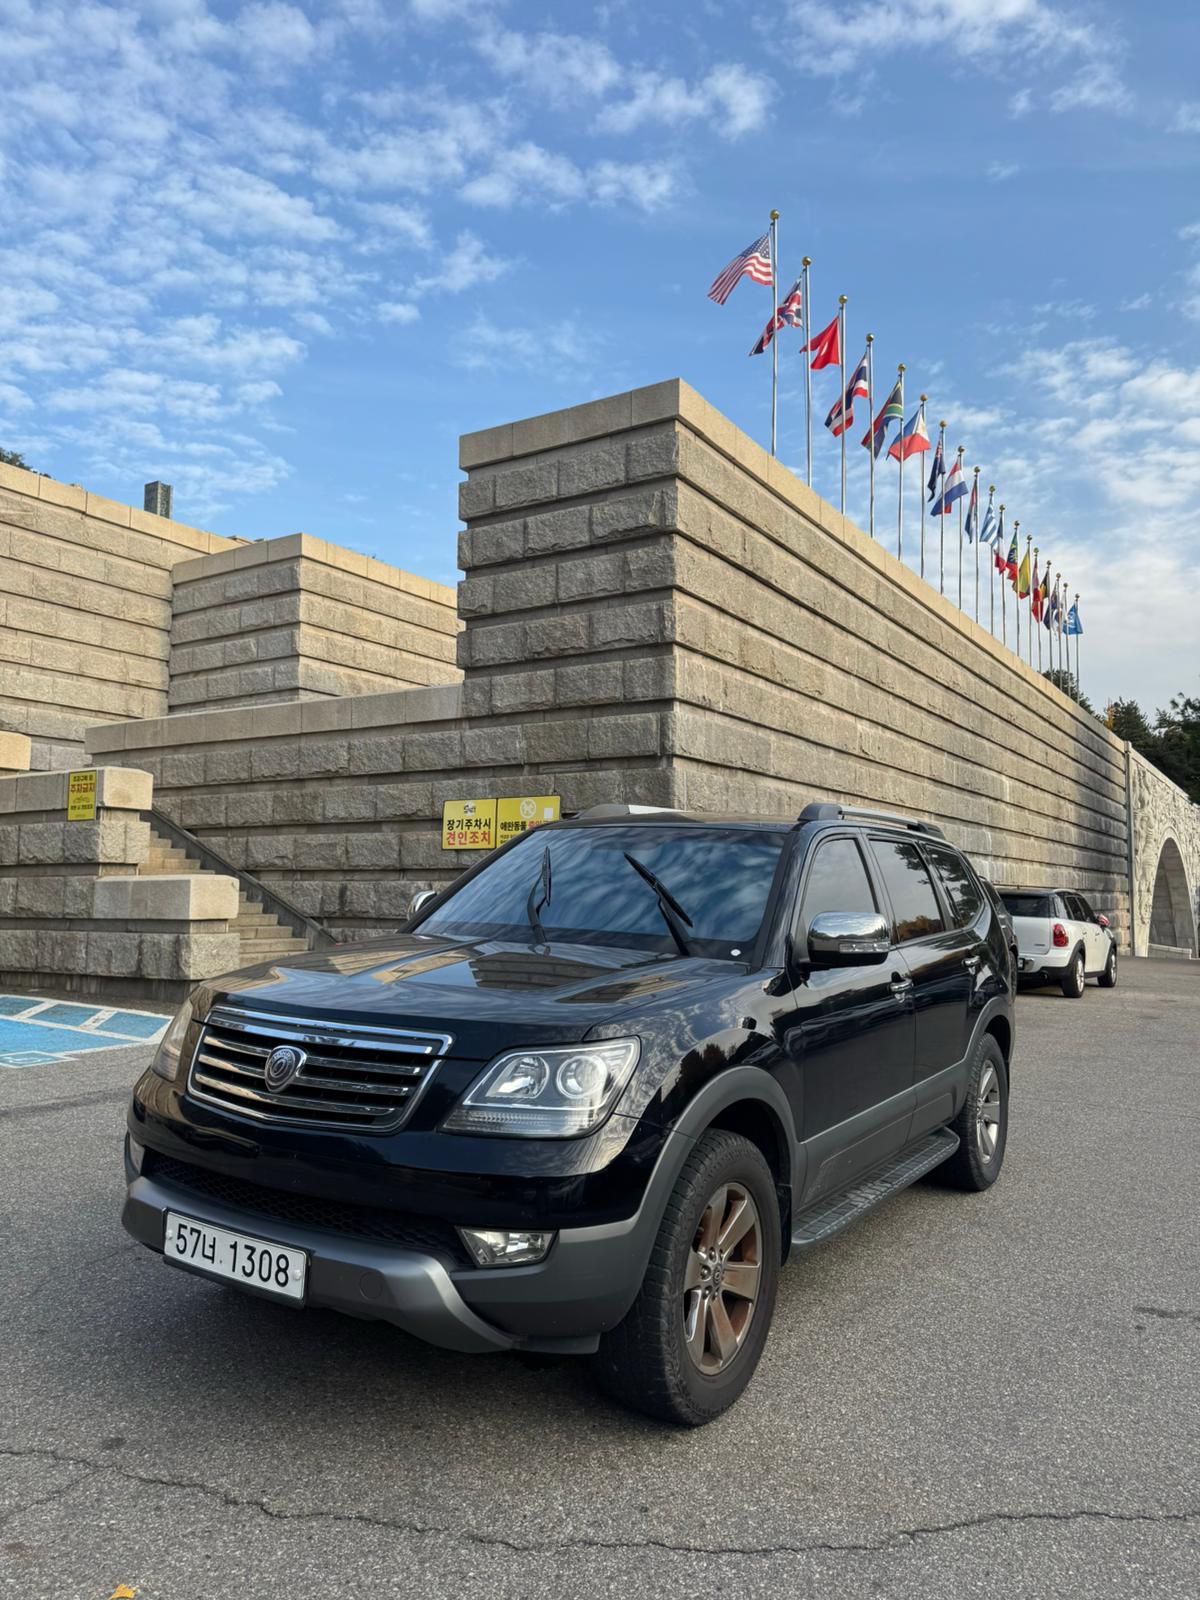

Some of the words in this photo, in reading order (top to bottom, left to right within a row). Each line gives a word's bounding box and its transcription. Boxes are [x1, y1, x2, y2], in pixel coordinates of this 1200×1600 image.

[447, 818, 492, 831] 장기주차시
[500, 821, 527, 831] 애완동물
[446, 831, 491, 846] 견인조치
[175, 1223, 216, 1264] 57너
[229, 1240, 290, 1288] 1308
